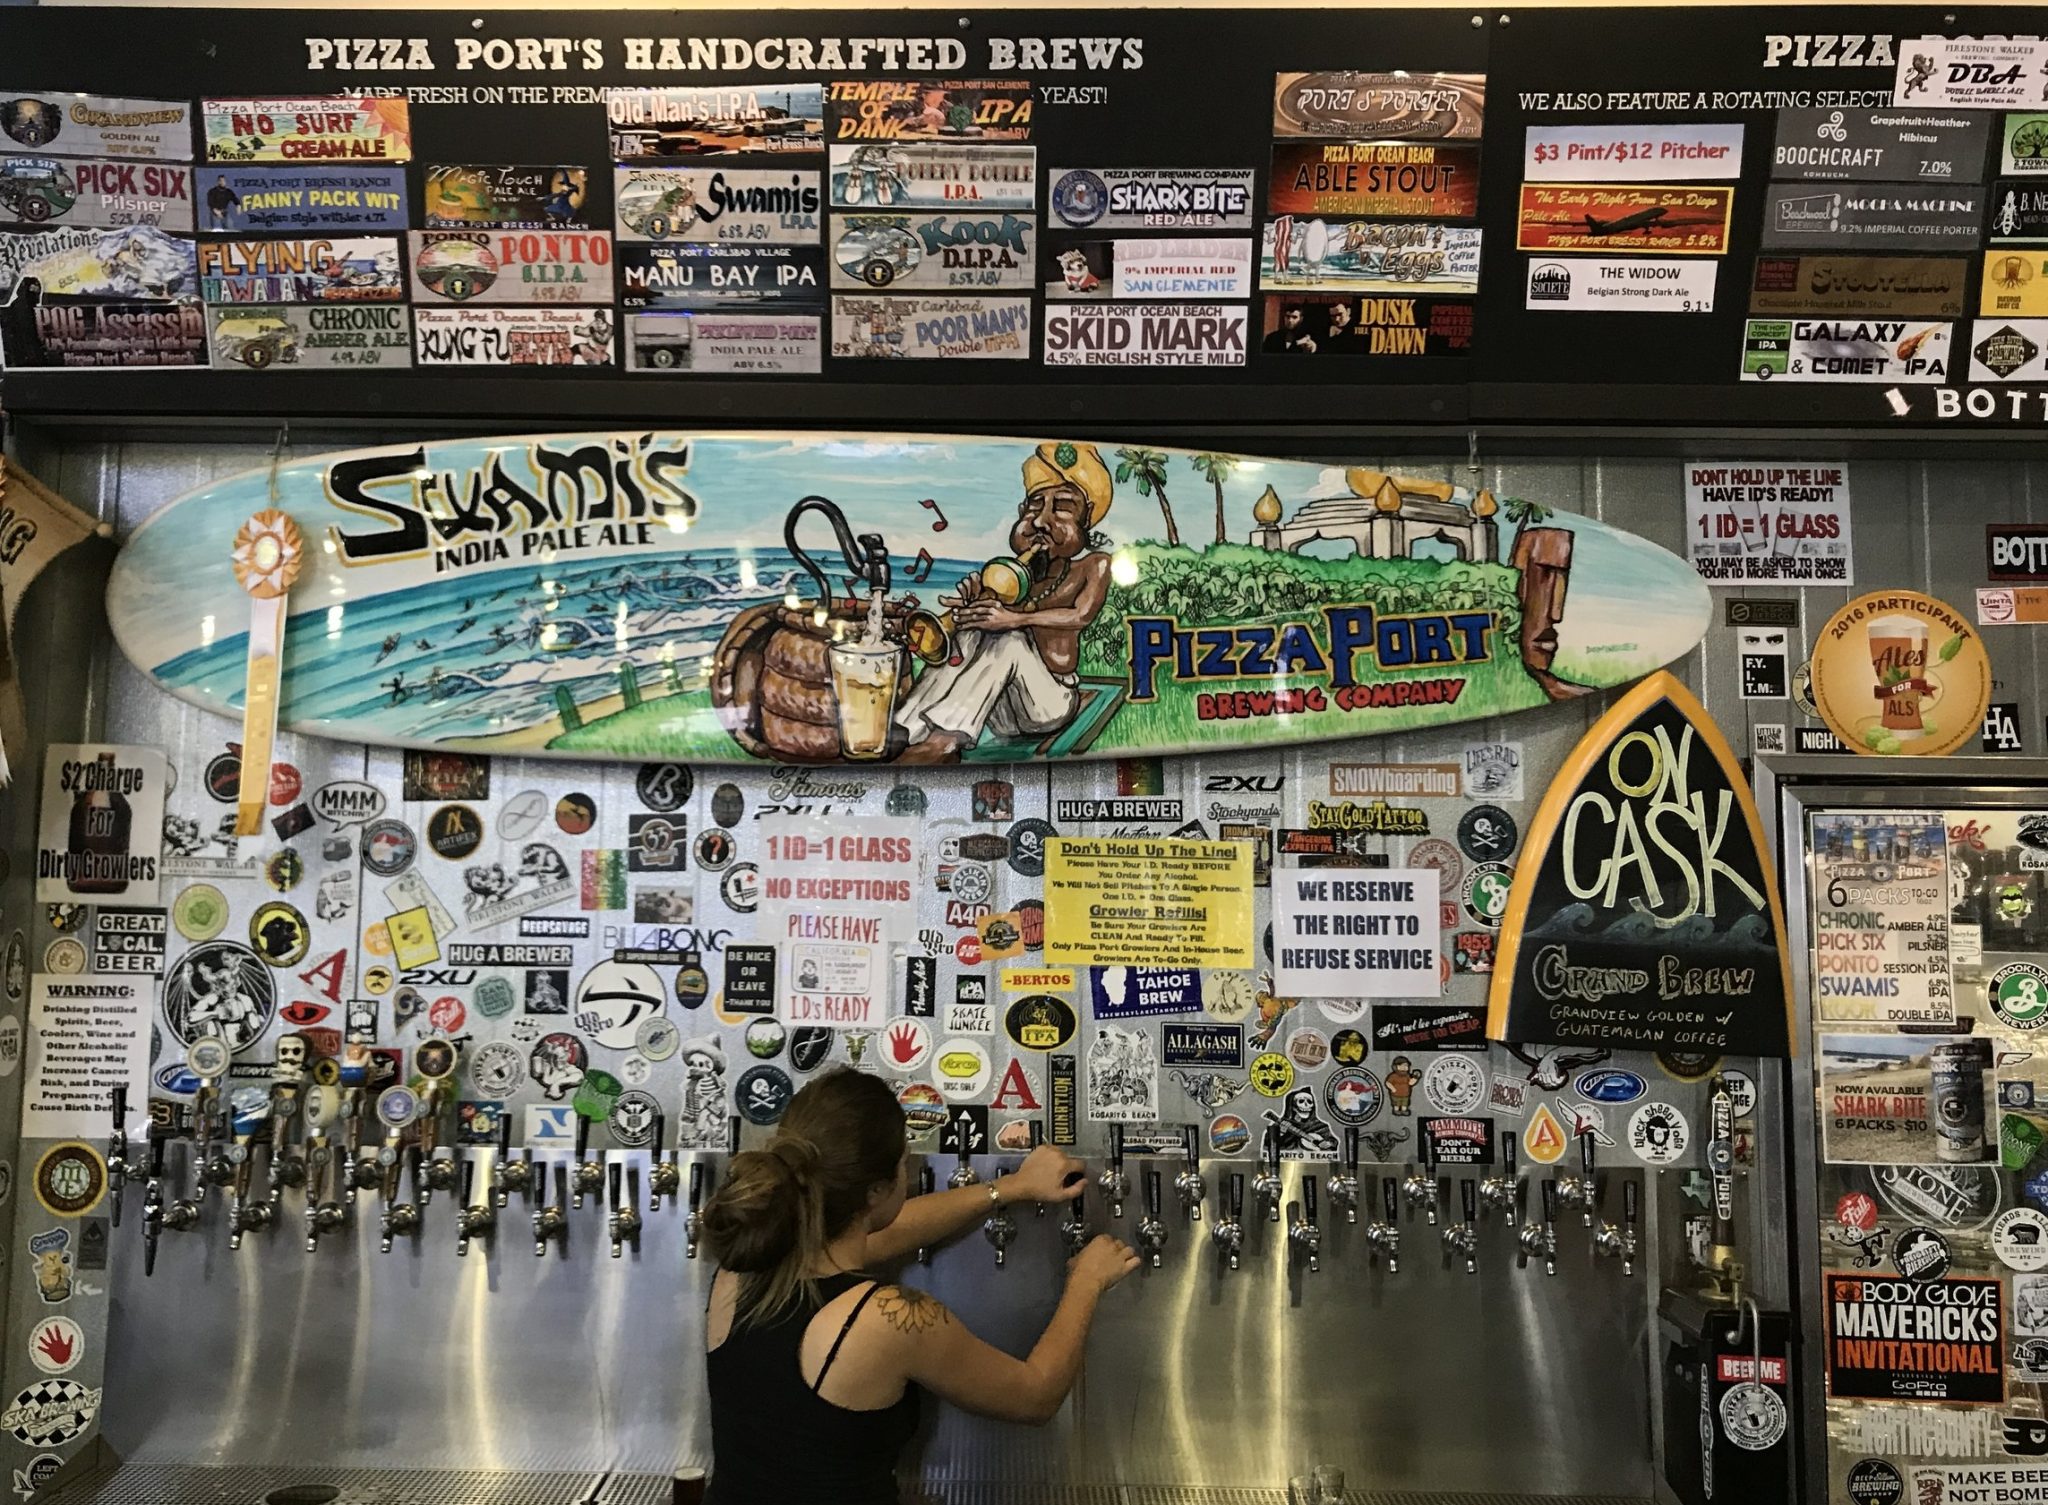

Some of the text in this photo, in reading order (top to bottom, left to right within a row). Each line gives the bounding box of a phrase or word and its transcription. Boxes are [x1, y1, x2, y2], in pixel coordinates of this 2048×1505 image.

[305, 38, 1143, 70] PIZZA PORT'S HANDCRAFTED BREWS
[1764, 35, 1895, 67] PIZZA
[408, 87, 549, 104] FRESH ON THE
[1039, 87, 1108, 104] YEAST!
[1519, 91, 1892, 110] WE ALSO FEATURE A ROTATING SELECTI
[831, 82, 920, 139] TEMPLE OF DANK
[975, 100, 1033, 124] IPA
[232, 113, 357, 136] NO SURF
[281, 139, 386, 158] CREAM ALE
[1534, 142, 1730, 163] $3 Pint/$12 Pitcher
[1776, 147, 1883, 167] BOOCHCRAFT
[76, 164, 187, 200] PICK SIX
[1293, 163, 1455, 193] ABLE STOUT
[101, 194, 168, 212] Pilsner
[242, 190, 401, 212] FANNY PACK WIT
[1144, 214, 1213, 226] RED ALE
[198, 241, 334, 275] FLYING
[500, 234, 610, 266] PONTO
[1600, 267, 1681, 279] THE WIDOW
[1587, 287, 1689, 297] Belgian Strong Dark Ale
[308, 308, 401, 331] CHRONIC
[1070, 306, 1222, 316] PIZZA PORT OCEAN BEACH
[1359, 299, 1417, 326] DUSK
[304, 333, 409, 348] AMBER ALE
[1047, 317, 1245, 350] SKID MARK
[1369, 327, 1428, 355] DAWN
[1794, 323, 1906, 342] GALAXY
[1046, 352, 1245, 365] 4.5% ENGLISH STYLE MILD
[1692, 469, 1842, 486] DONT HOLD UP THE LINE
[1702, 488, 1834, 502] HAVE ID'S READY!
[1698, 515, 1709, 538] 1
[1717, 514, 1738, 538] ID
[1759, 514, 1769, 538] 1
[1775, 514, 1840, 538] GLASS
[435, 523, 656, 573] INDIA PALE ALE
[1830, 608, 1864, 641] 2016
[1866, 597, 1973, 642] PARTICIPANT
[1126, 604, 1497, 703] PIZZA PORT
[1891, 681, 1913, 695] FOR
[1198, 678, 1466, 720] BREWING COMPANY
[1887, 699, 1915, 716] ALS
[1608, 723, 1694, 807] ON
[61, 761, 144, 796] $2 Charge
[1334, 768, 1456, 795] SNOWboarding
[1059, 803, 1181, 817] HUG A BREWER
[86, 806, 115, 837] For
[767, 836, 777, 860] 1
[839, 837, 911, 863] GLASS
[1061, 843, 1237, 859] Don't Hold Up The Line!
[1562, 789, 1766, 929] CASK
[765, 878, 910, 902] NO EXCEPTIONS
[1297, 881, 1414, 901] WE RESERVE
[98, 915, 164, 931] GREAT.
[788, 914, 882, 944] PLEASE HAVE
[1293, 915, 1419, 936] THE RIGHT TO
[97, 956, 162, 971] BEER.
[1282, 949, 1433, 969] REFUSE SERVICE
[1532, 944, 1755, 1002] GRAND BREW
[1994, 965, 2048, 984] BROOKLYN
[48, 985, 136, 998] WARNING:
[1820, 977, 1949, 997] SWAMIS IPA
[949, 1007, 992, 1031] SKATE JUNKEE
[1550, 1004, 1640, 1023] GRANDVIEW
[1647, 1010, 1704, 1024] GOLDEN
[1167, 1033, 1238, 1050] ALLAGASH
[1556, 1022, 1727, 1046] GUATEMALAN COFFEE
[1835, 1085, 1924, 1095] NOW AVAILABLE
[1834, 1095, 1926, 1118] SHARK BITE
[1835, 1119, 1927, 1131] 6 PACKS $10
[1862, 1282, 1996, 1307] BODY GLOVE
[1836, 1303, 1998, 1342] MAVERICKS
[1837, 1339, 1998, 1374] INVITATIONAL
[1892, 1380, 1947, 1390] GoPro
[1948, 1472, 2006, 1484] MAKE
